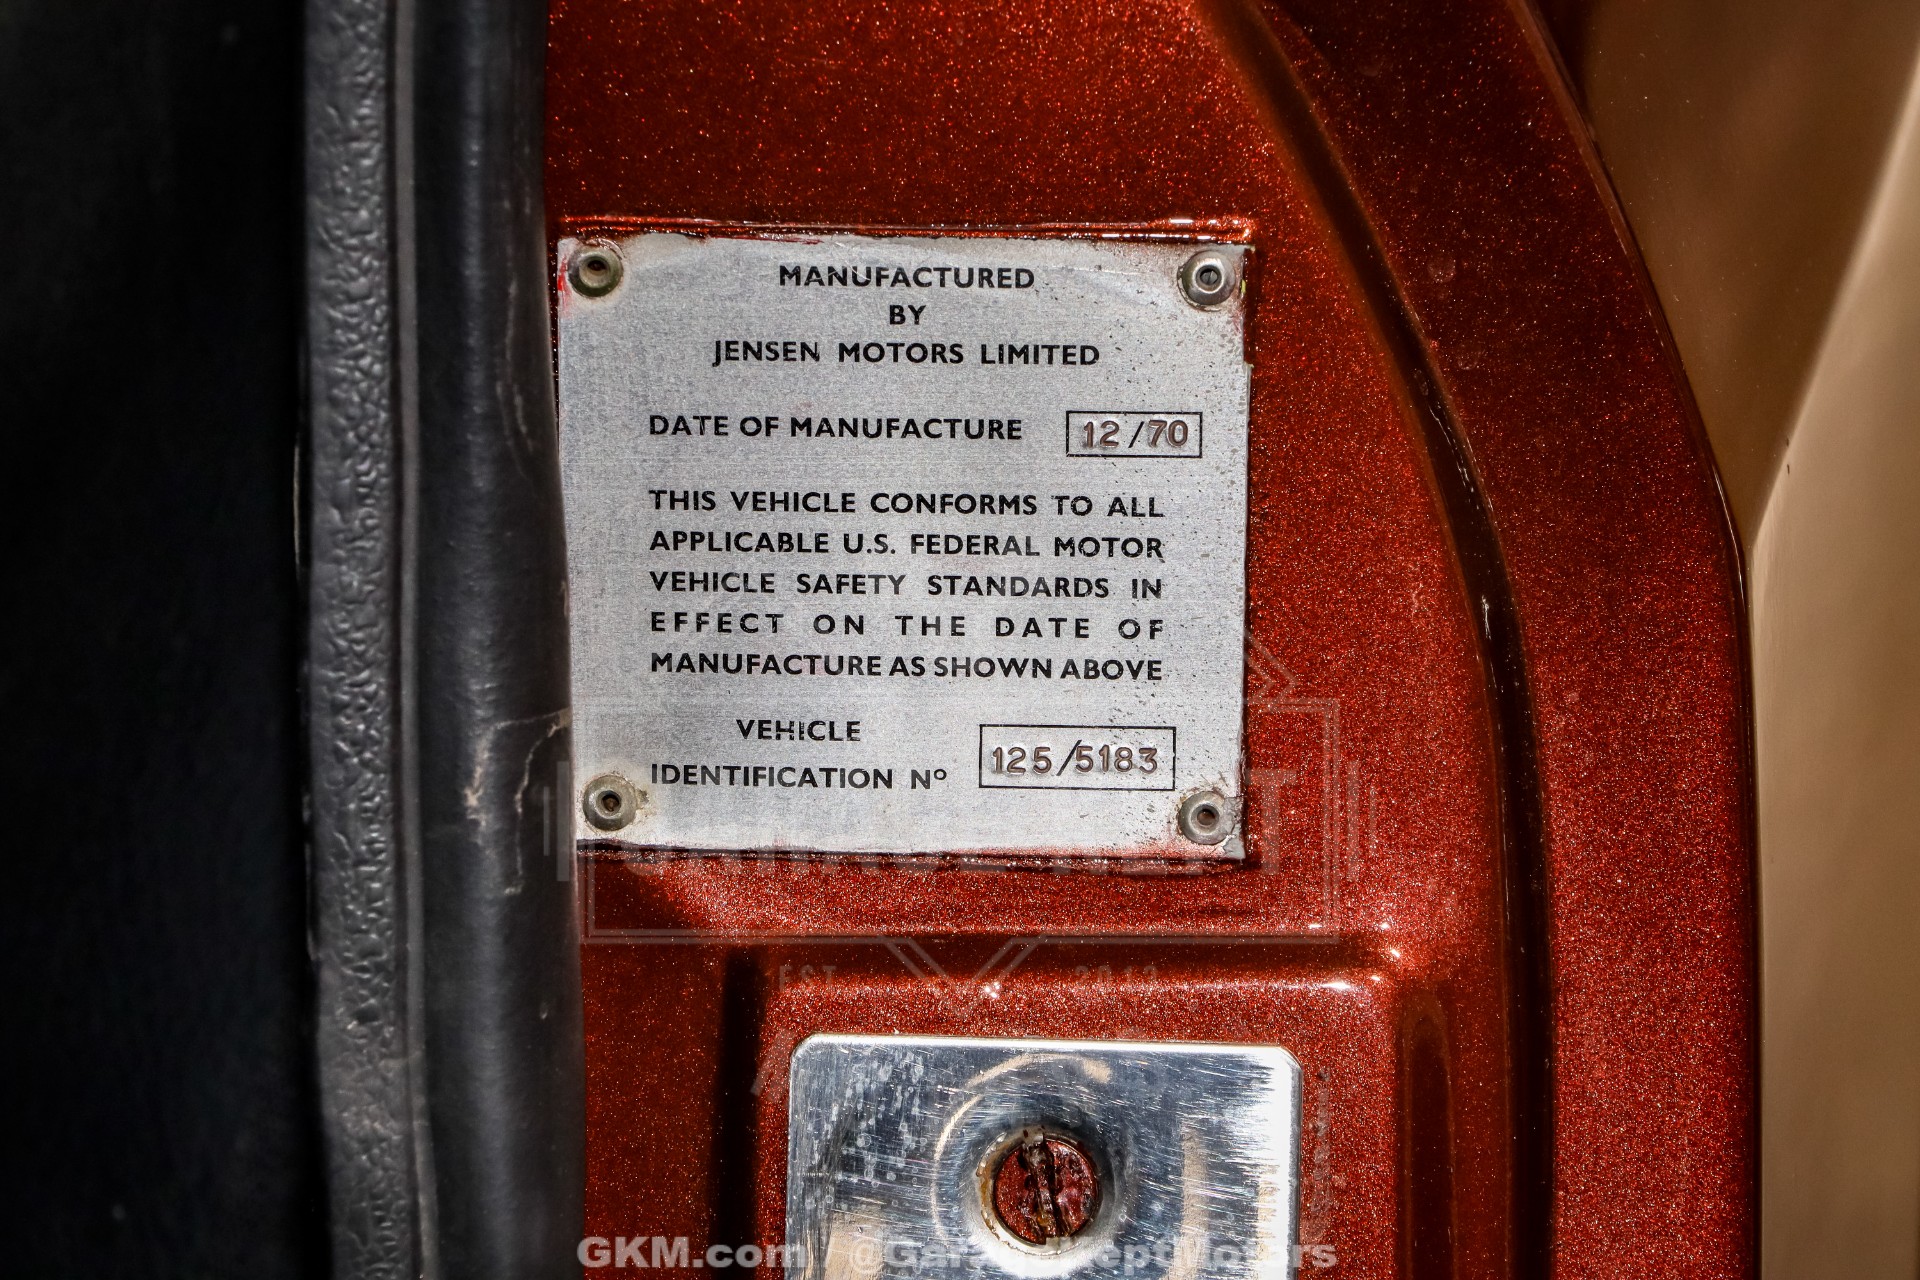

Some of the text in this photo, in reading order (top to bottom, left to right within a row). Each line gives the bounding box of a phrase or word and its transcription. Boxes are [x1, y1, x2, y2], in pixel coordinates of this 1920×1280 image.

[780, 265, 1034, 288] MANUFACTURED
[890, 305, 926, 325] BY
[712, 340, 1099, 367] JENSEN MOTORS LIMITED
[650, 415, 1188, 448] DATE OF MANUFACTURE 12/70
[649, 490, 1165, 517] THIS VEHICLE CONFORMS TO ALL
[650, 531, 1163, 558] APPLICABLE U.S. FEDERAL MOTOR
[649, 571, 1161, 599] VEHICLE SAFETY STANDARDS IN
[651, 612, 1163, 639] EFFECT ON THE DATE OF
[652, 653, 1162, 680] MANUFACTURE AS SHOWN ABOVE
[736, 719, 860, 741] VEHICLE
[652, 764, 892, 789] IDENTIFICATION
[993, 740, 1157, 776] 125/5183
